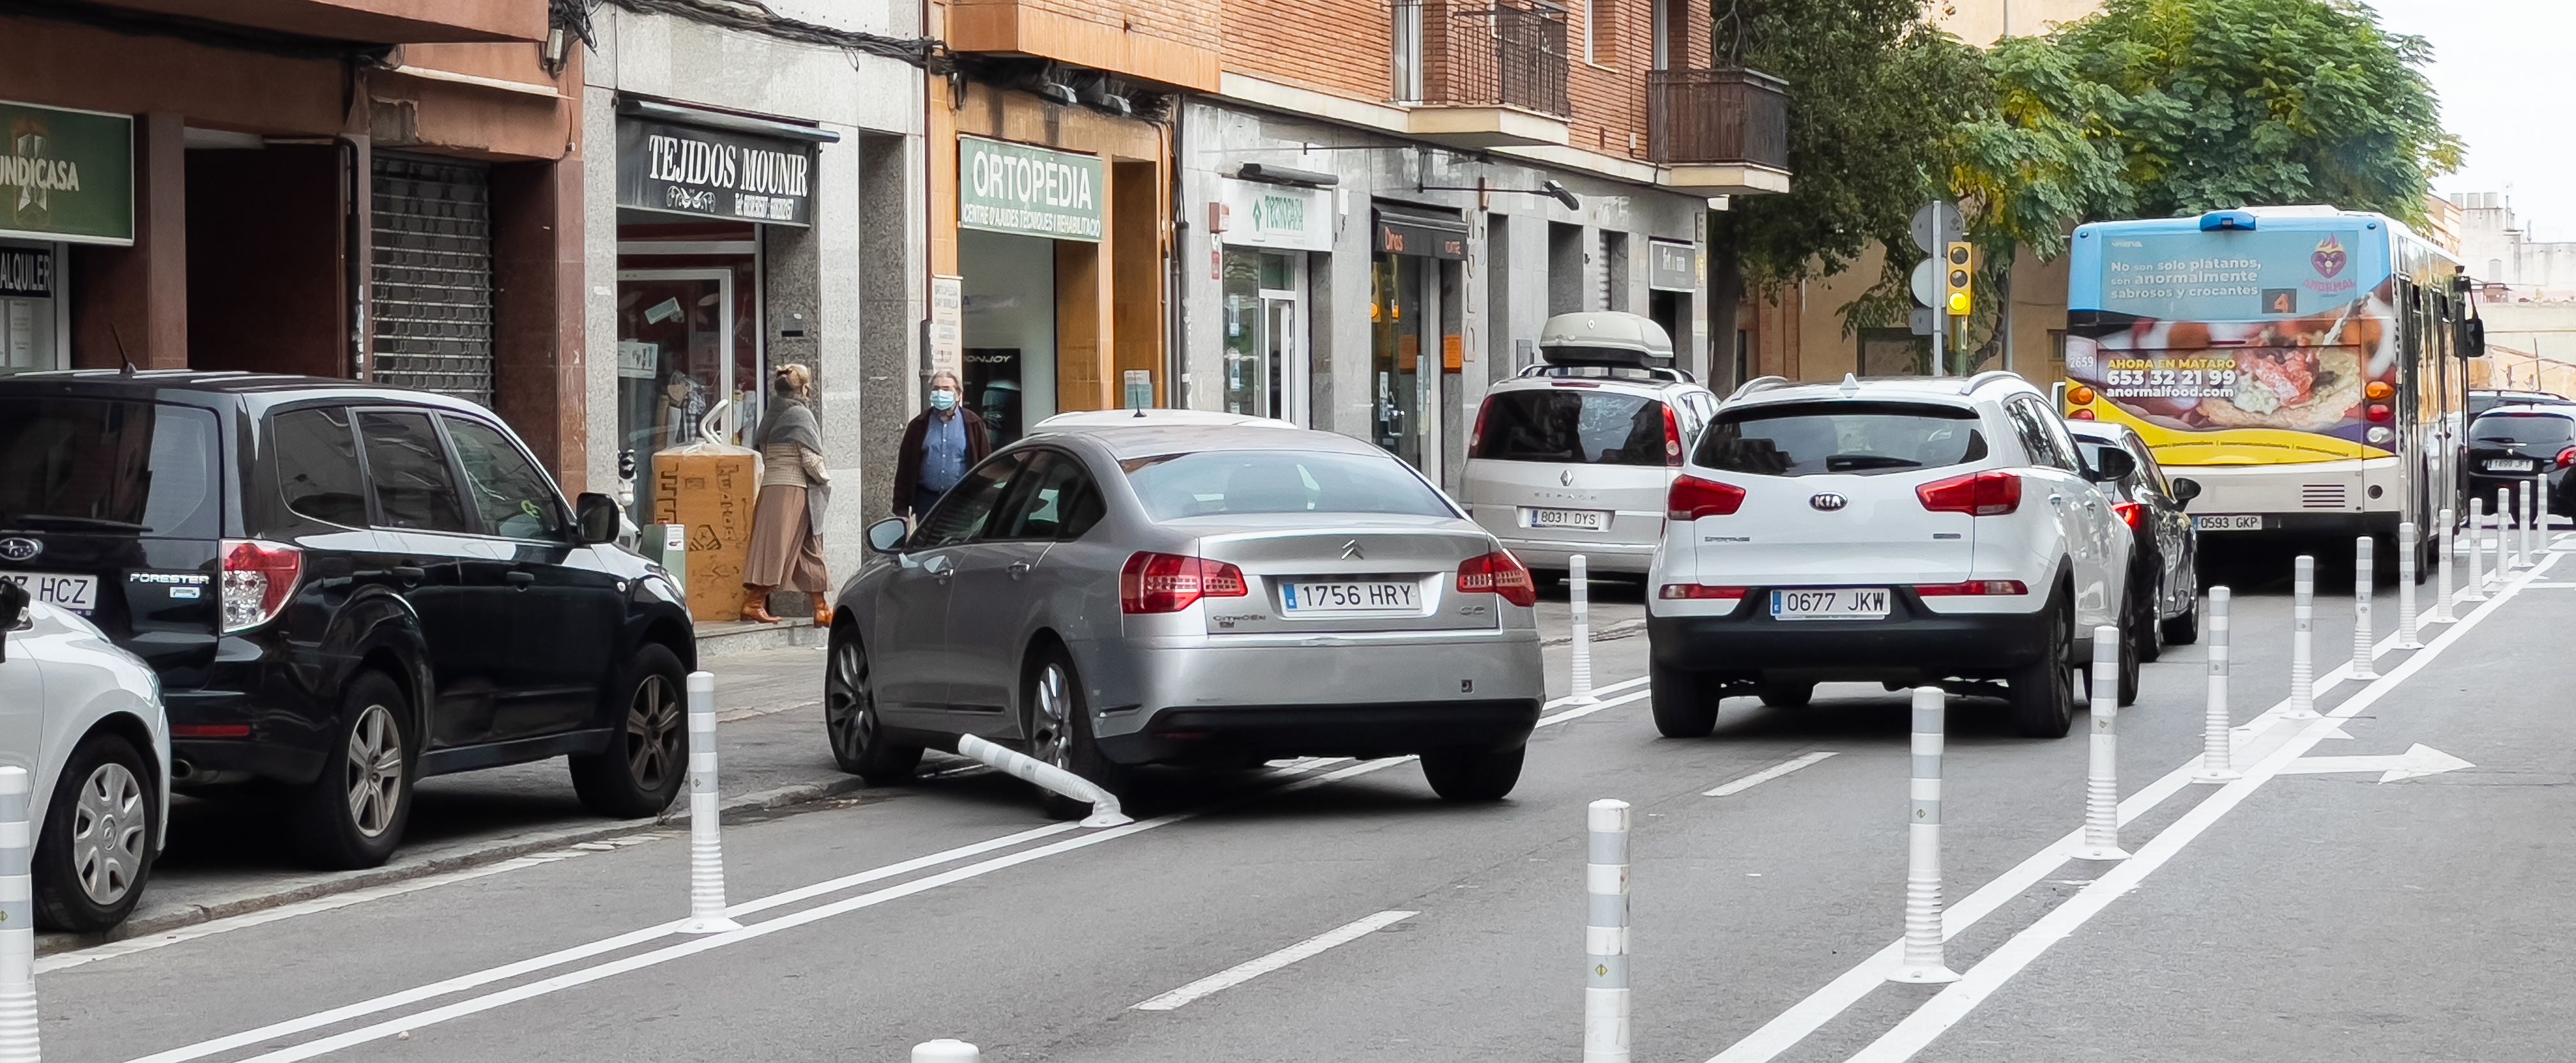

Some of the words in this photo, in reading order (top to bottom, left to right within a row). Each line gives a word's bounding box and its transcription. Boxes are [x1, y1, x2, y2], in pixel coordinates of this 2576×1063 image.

[648, 135, 736, 188] TEJIDOS
[740, 148, 808, 197] MOUNIR
[965, 203, 989, 225] CENTRE
[989, 207, 1020, 228] D'AJUDES
[0, 252, 51, 291] ALQUILER
[2111, 262, 2129, 271] No
[2157, 260, 2186, 270] solo
[2135, 270, 2258, 285] anormalmente
[2111, 288, 2173, 298] sabrosos
[2177, 288, 2186, 299] y
[2189, 286, 2258, 296] crocantes
[2273, 293, 2290, 313] 4
[2069, 356, 2094, 369] 2659
[2108, 359, 2156, 369] AHORA
[2158, 359, 2175, 369] EN
[2106, 370, 2144, 386] 653
[2150, 370, 2175, 386] 32
[2181, 369, 2202, 386] 21
[2209, 369, 2236, 386] 99
[2106, 386, 2234, 398] anormalfood.com
[1815, 496, 1841, 507] KIA
[1541, 511, 1567, 523] 8031
[1575, 513, 1595, 524] DYS
[2200, 517, 2229, 528] 0593
[2236, 517, 2257, 528] GKP
[130, 572, 210, 584] FORESTER
[40, 577, 88, 604] HCZ
[1303, 585, 1361, 606] 1756
[1369, 585, 1412, 606] HRY
[1787, 593, 1836, 611] 0677
[1848, 592, 1884, 611] JKW
